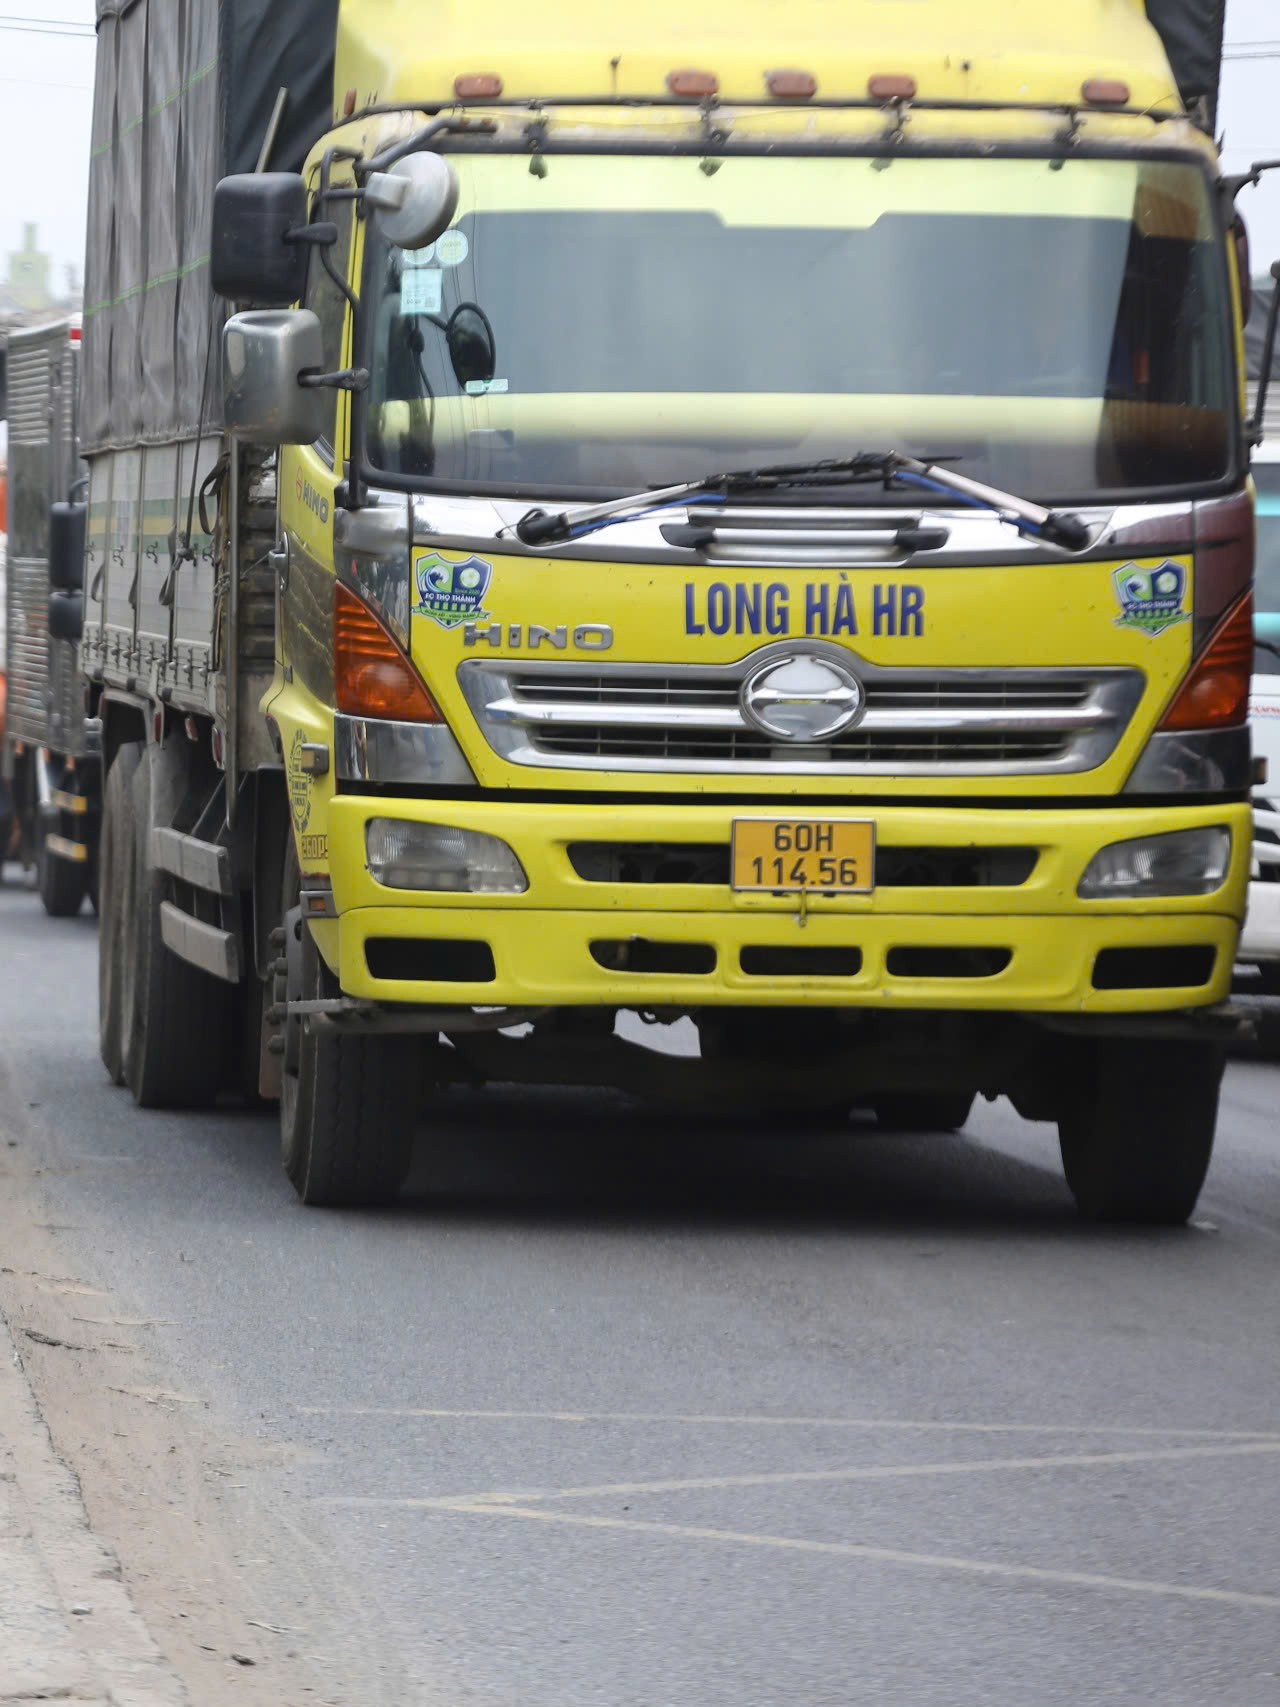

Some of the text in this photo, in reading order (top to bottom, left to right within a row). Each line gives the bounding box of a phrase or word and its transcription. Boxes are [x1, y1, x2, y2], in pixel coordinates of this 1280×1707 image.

[304, 480, 329, 524] HINO
[425, 592, 435, 600] FC
[685, 571, 926, 637] LONG HÀ HR
[464, 621, 614, 650] HINO
[774, 822, 834, 852] 60H
[752, 855, 858, 886] 114.56
